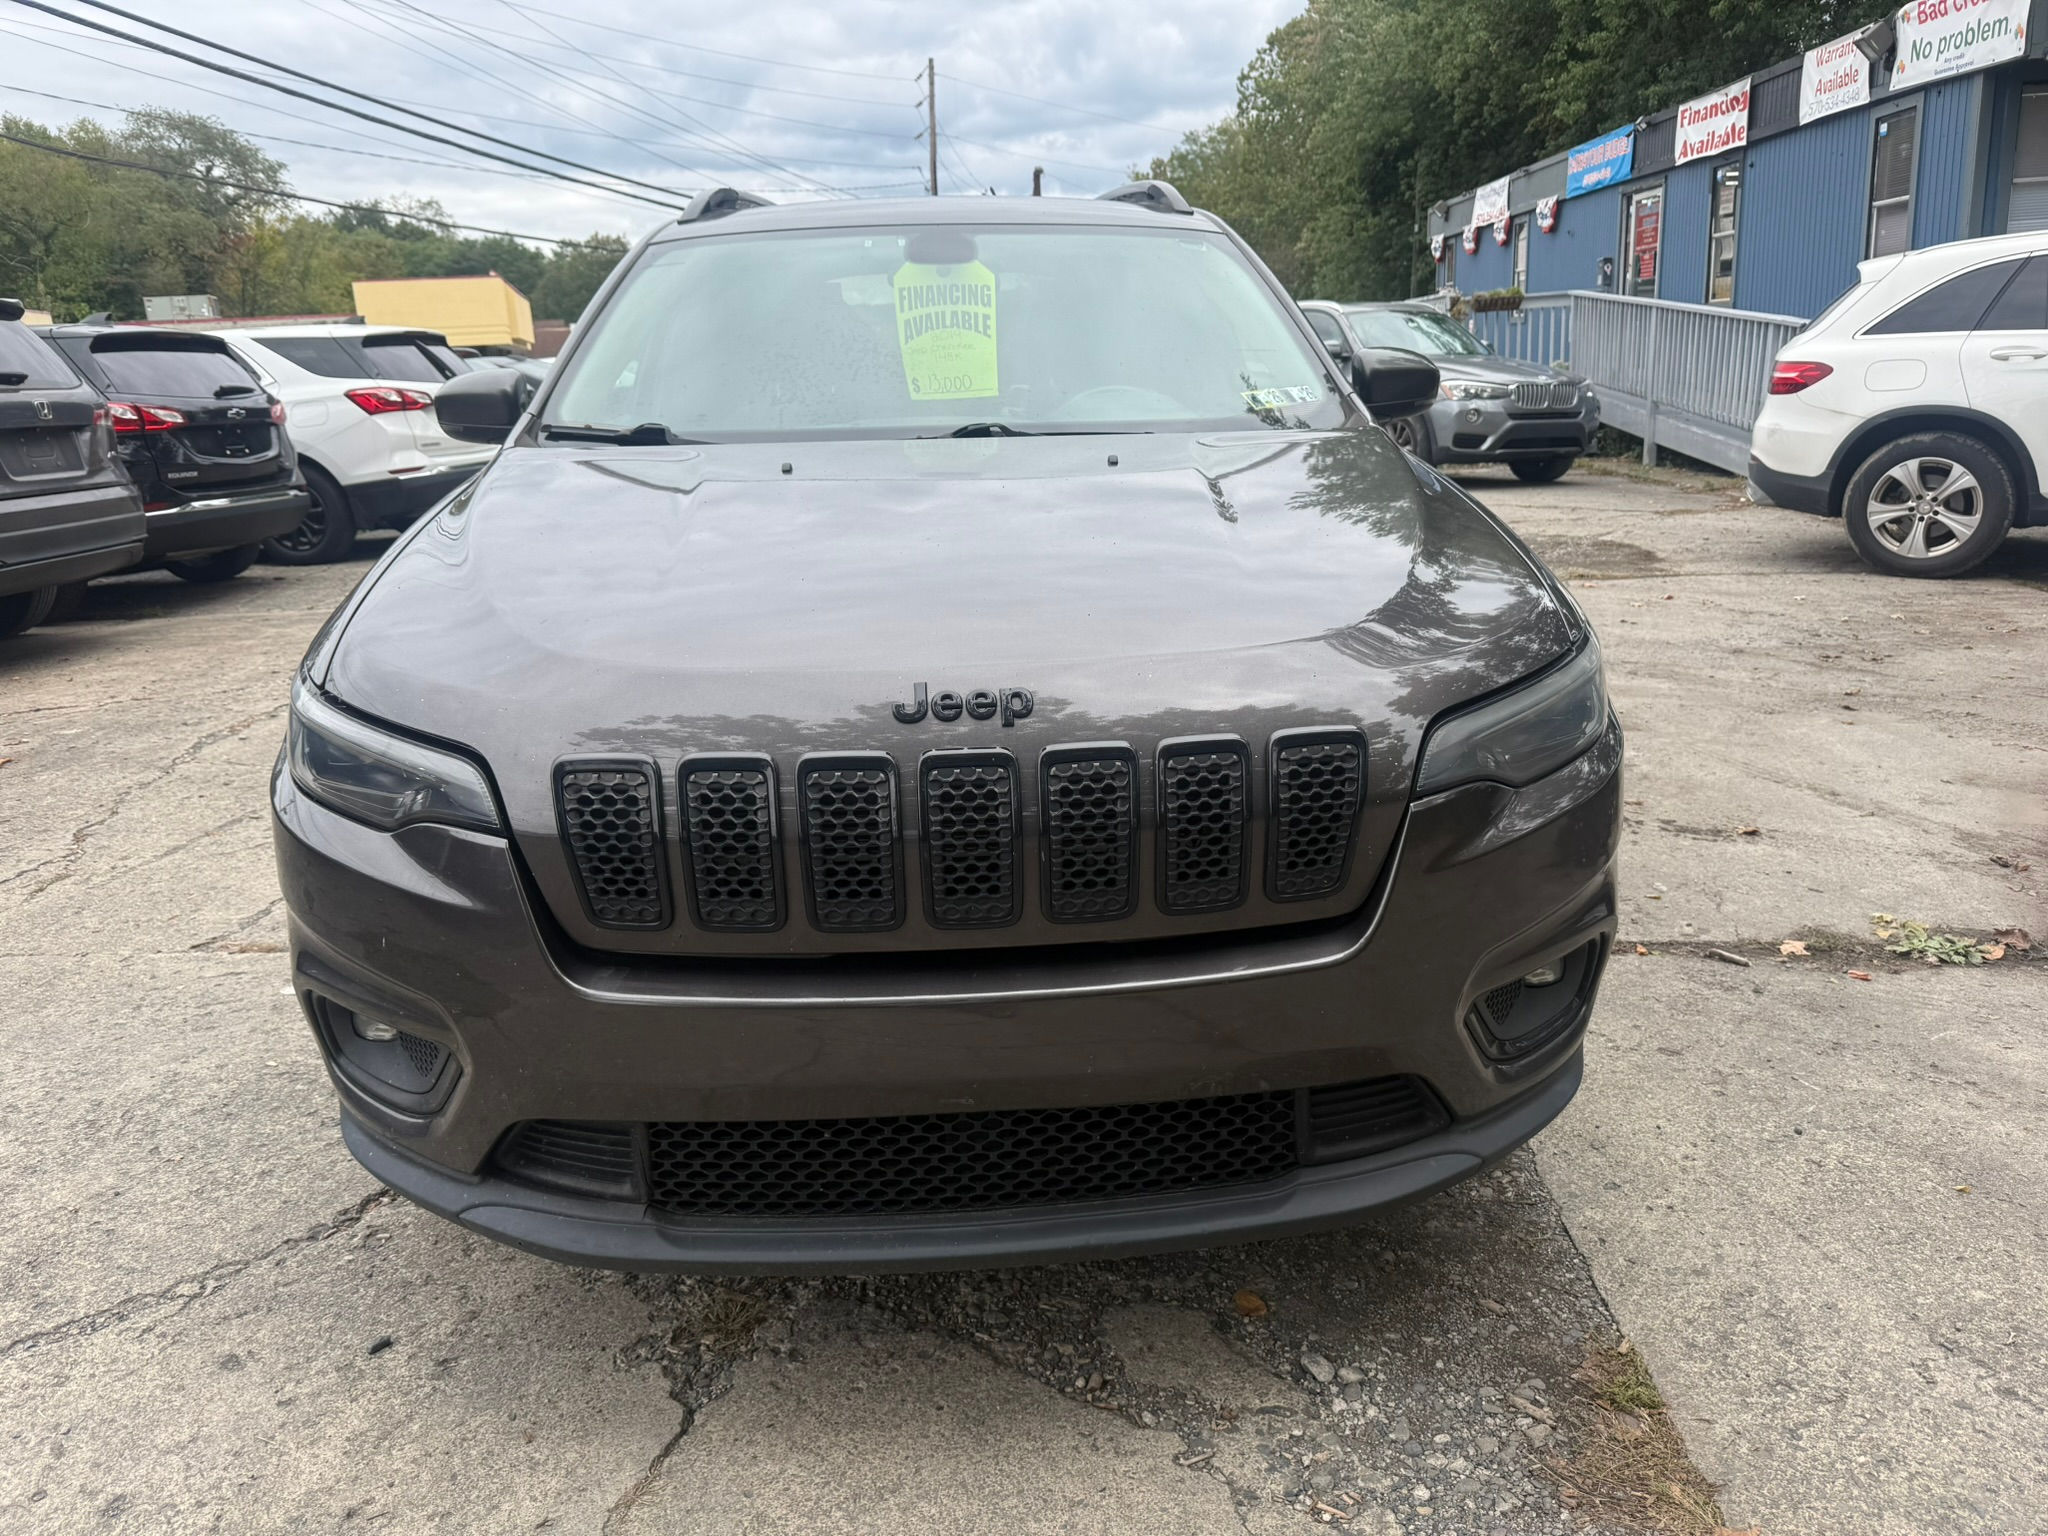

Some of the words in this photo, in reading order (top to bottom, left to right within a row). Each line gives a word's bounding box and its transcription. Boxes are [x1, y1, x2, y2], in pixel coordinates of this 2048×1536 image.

[1917, 0, 1948, 25] Bad
[1815, 37, 1858, 68] Warranty
[1910, 37, 1932, 63] No
[1936, 16, 2012, 62] problem.
[1814, 63, 1859, 97] Available
[1680, 90, 1748, 128] Financing
[1678, 123, 1745, 160] Available
[899, 284, 991, 313] FINANCING
[903, 310, 992, 344] AVAILABLE
[911, 376, 921, 394] $
[892, 681, 1034, 728] Jeep
